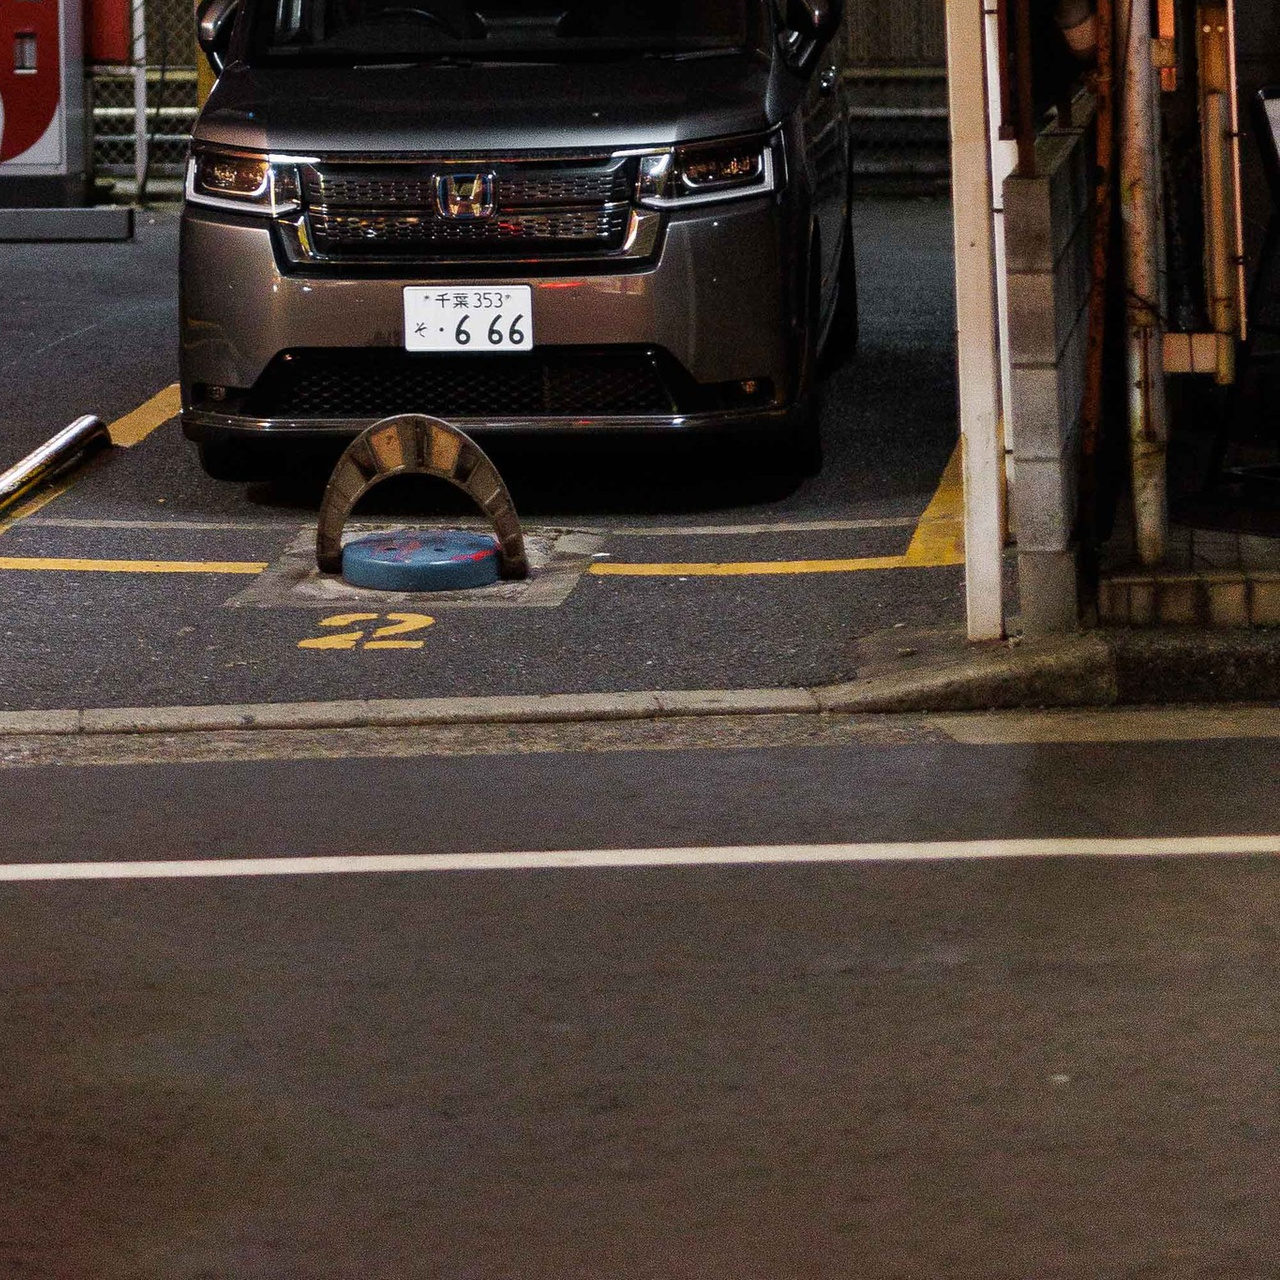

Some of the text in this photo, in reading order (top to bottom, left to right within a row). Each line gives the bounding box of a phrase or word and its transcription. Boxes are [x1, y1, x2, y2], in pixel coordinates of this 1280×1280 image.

[435, 292, 504, 309] 千葉 353
[296, 612, 437, 650] 2
